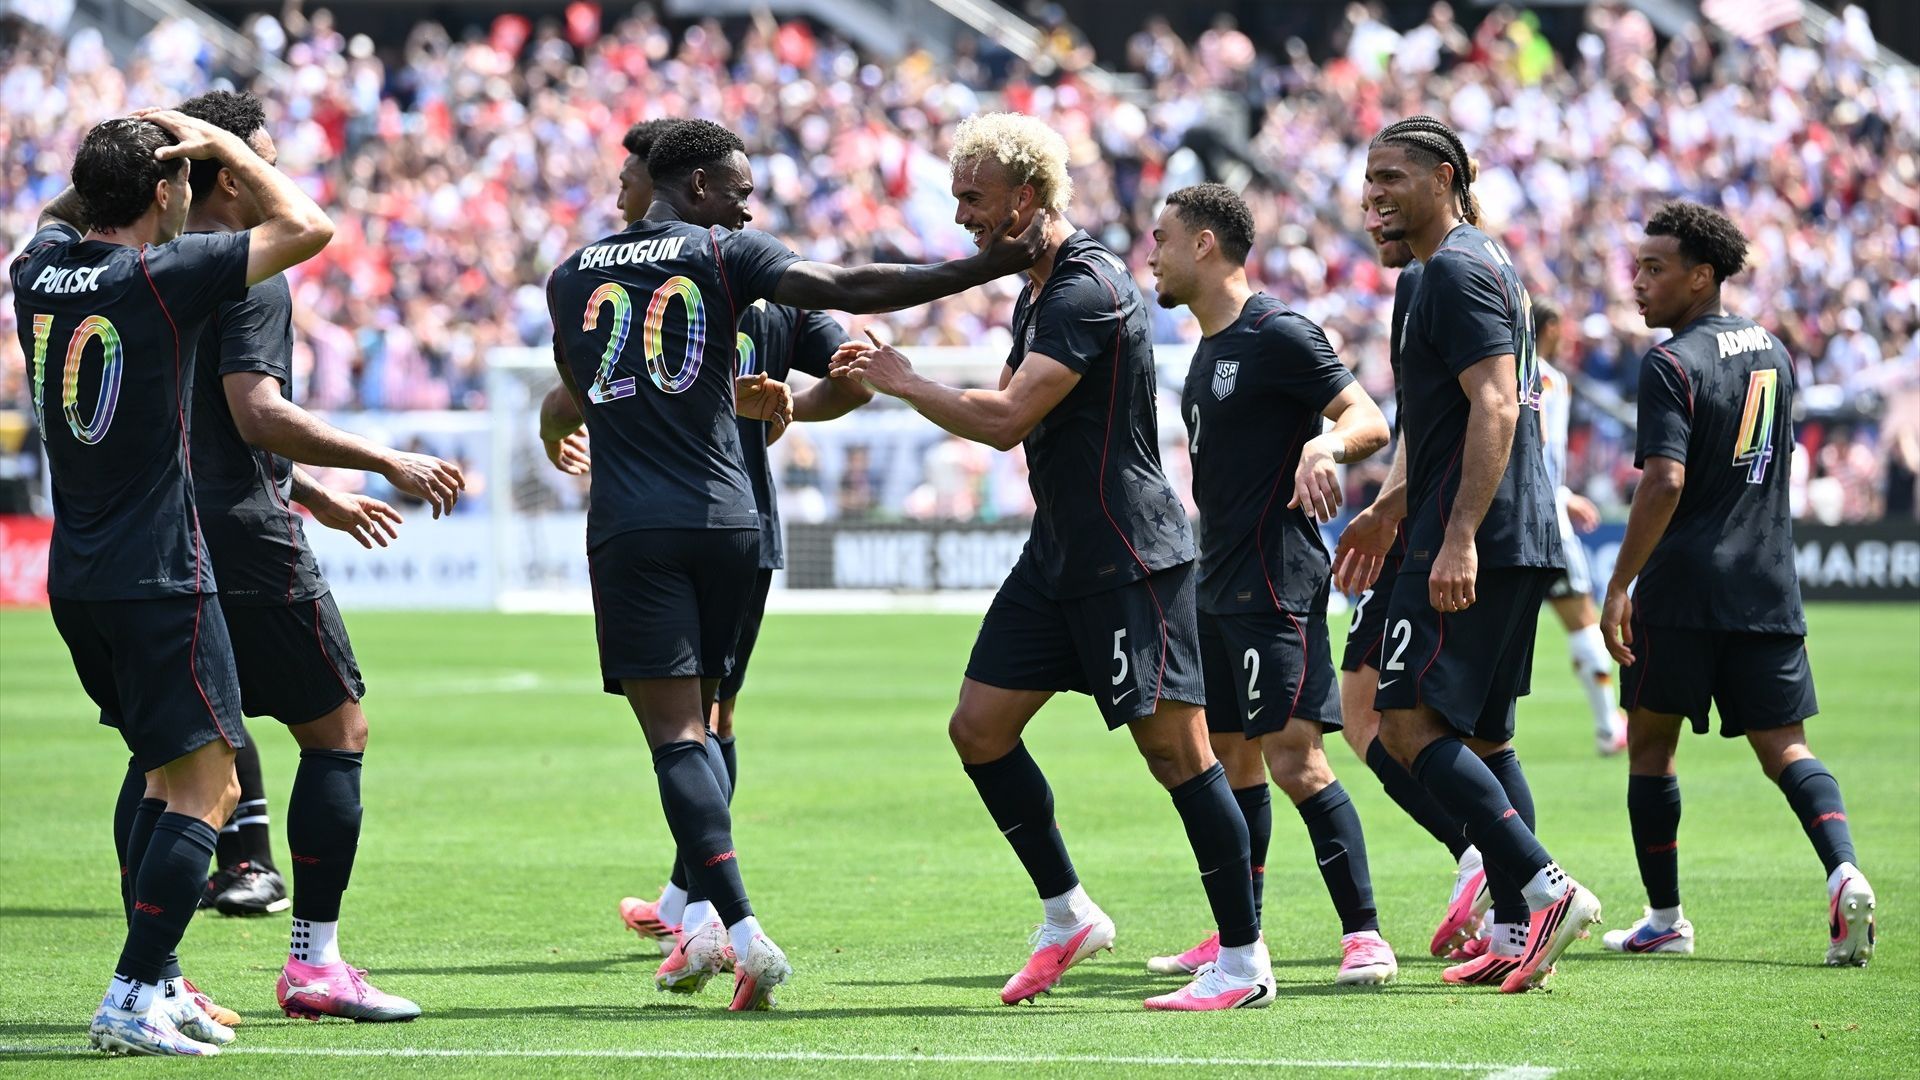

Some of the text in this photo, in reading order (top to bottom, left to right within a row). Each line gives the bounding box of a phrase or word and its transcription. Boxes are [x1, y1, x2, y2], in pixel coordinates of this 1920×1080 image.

[578, 236, 686, 270] BALOGUN
[582, 275, 706, 404] 20
[1716, 325, 1773, 359] ADAMS
[33, 314, 124, 445] 10
[1215, 362, 1237, 379] USA
[1190, 403, 1201, 454] 2
[1732, 368, 1777, 484] 4
[1111, 627, 1129, 686] 5
[1379, 618, 1412, 671] 12
[1243, 647, 1261, 701] 2
